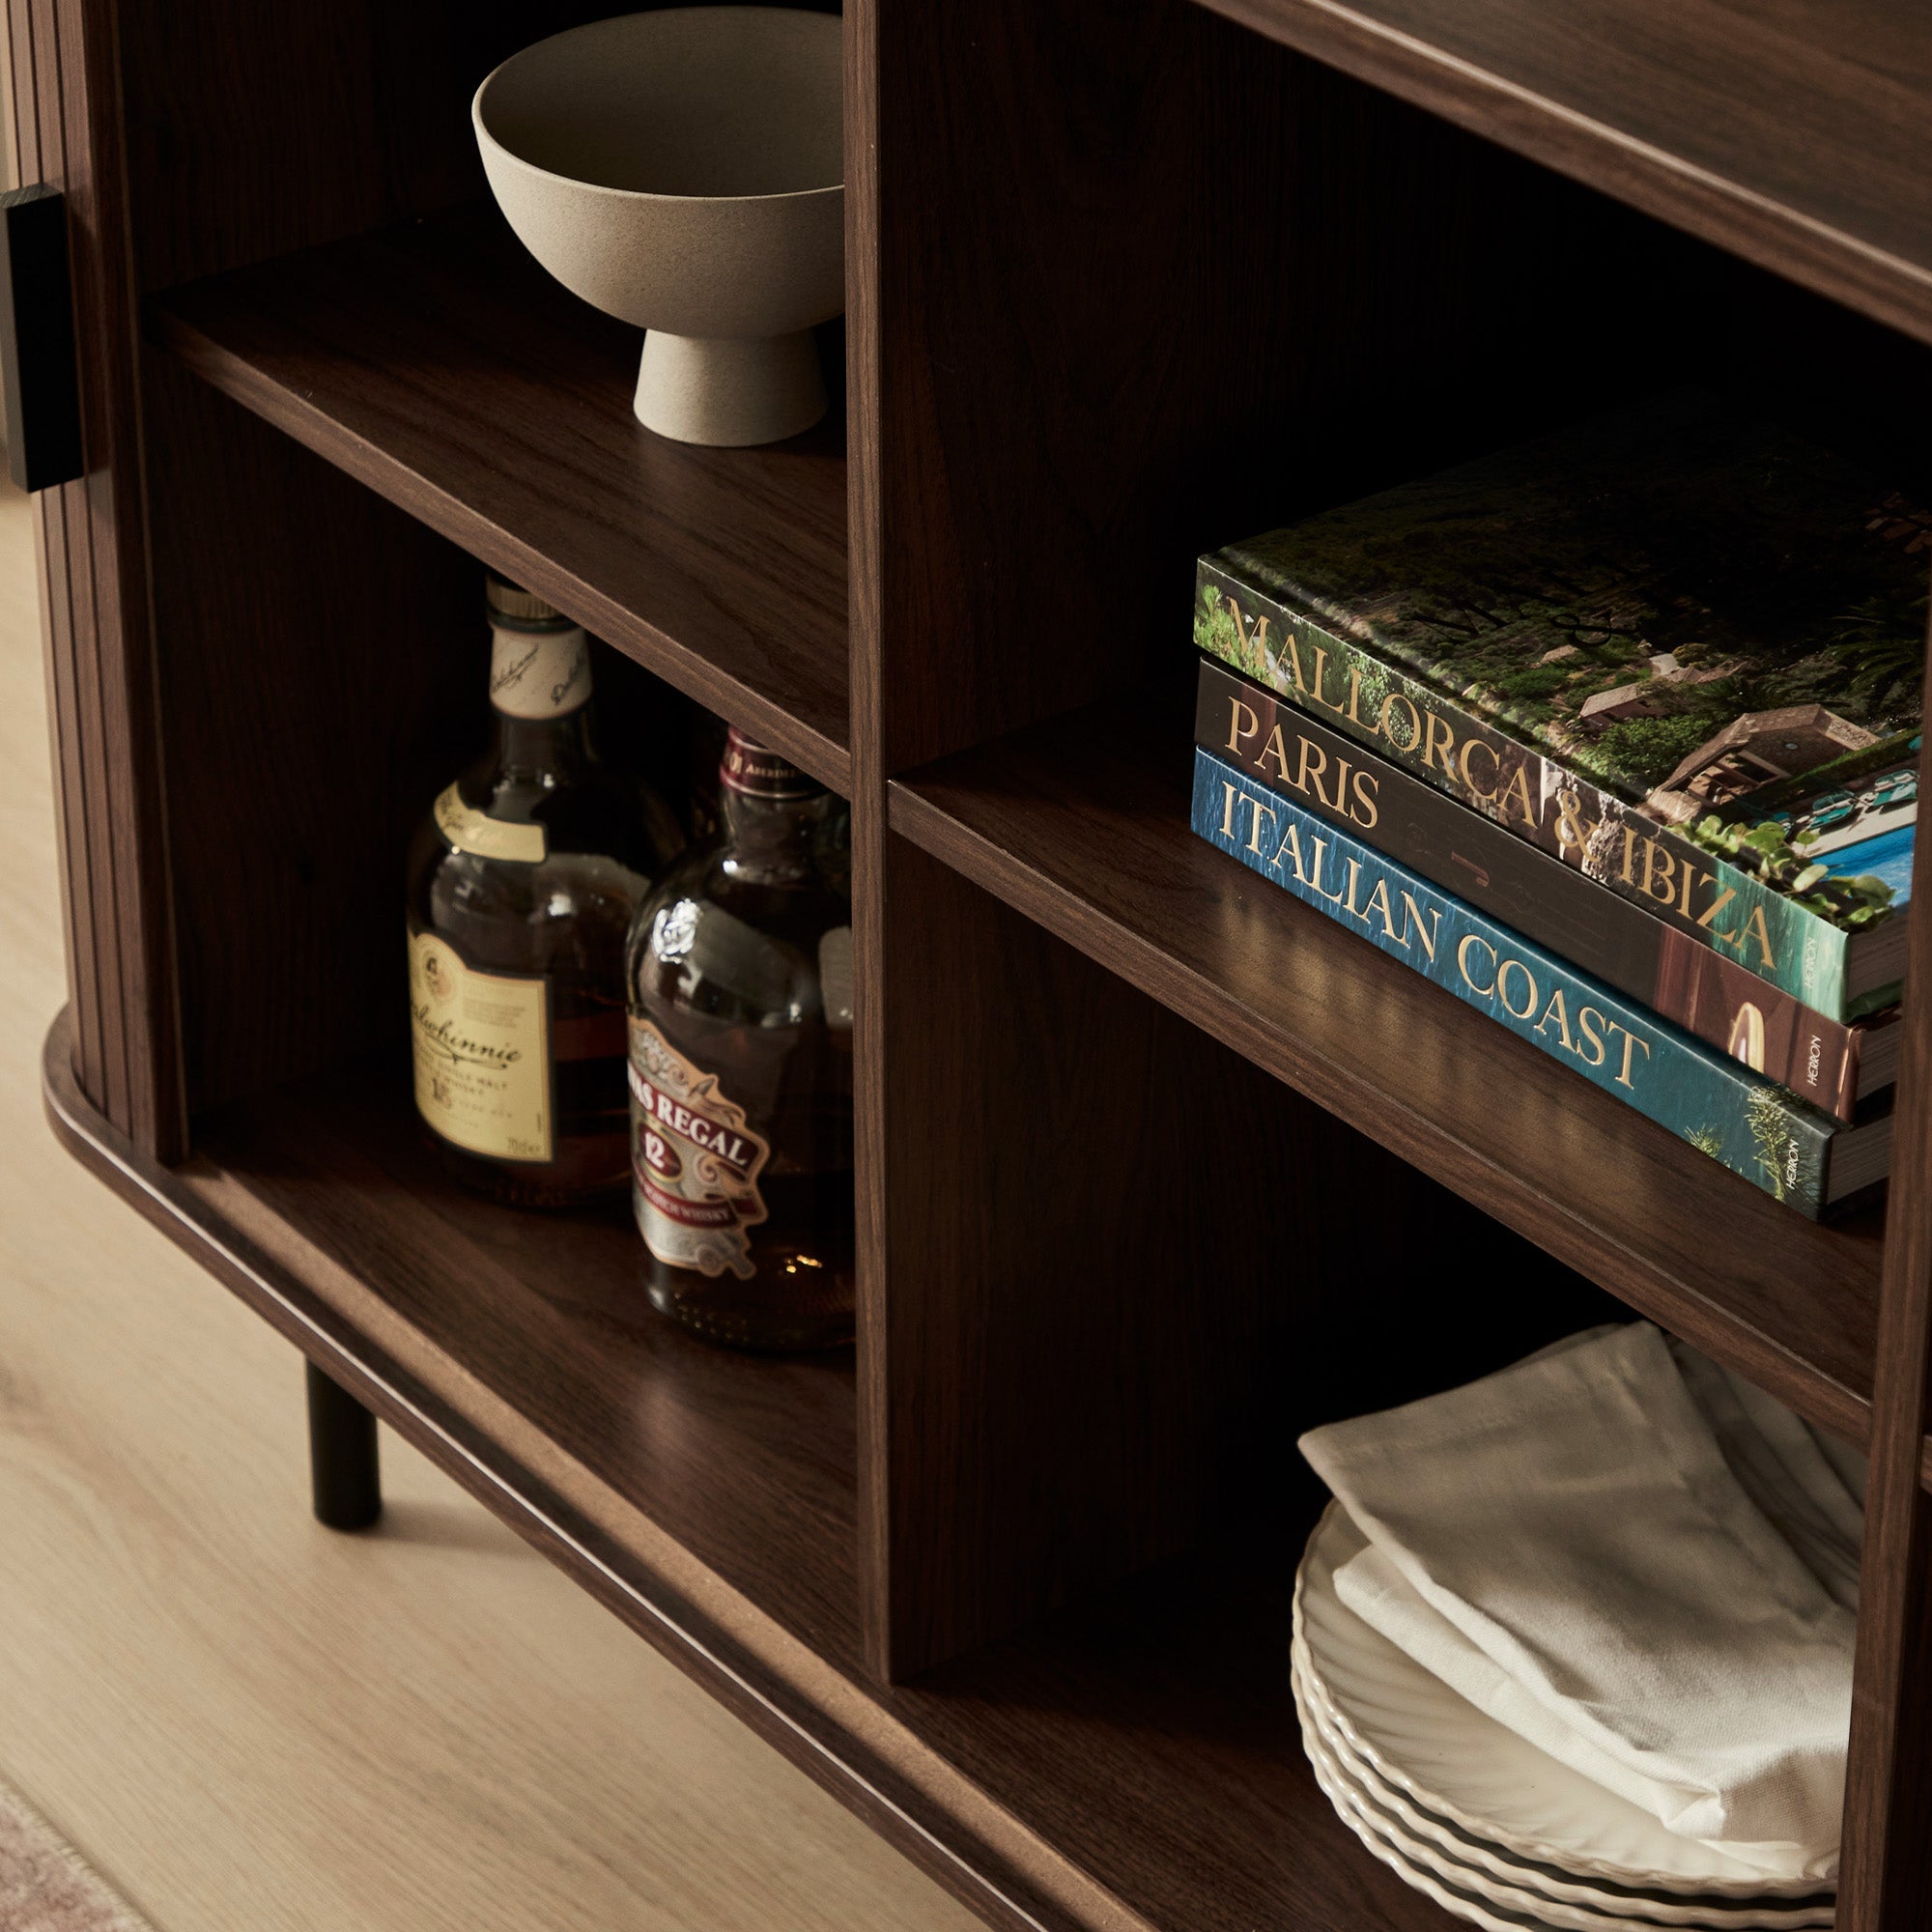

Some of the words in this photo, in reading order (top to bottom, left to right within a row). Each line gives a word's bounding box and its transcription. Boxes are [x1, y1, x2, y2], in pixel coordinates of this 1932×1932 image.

[1225, 696, 1379, 829] PARIS
[1227, 596, 1538, 830] MALLORCA
[1554, 790, 1603, 863] &
[1619, 825, 1777, 970] IBIZA
[1220, 781, 1443, 963] ITALIAN
[1458, 934, 1651, 1091] COAST
[1807, 1035, 1822, 1087] HERRON
[645, 1131, 666, 1169] 12
[657, 1094, 747, 1166] REGAL
[1786, 1139, 1800, 1190] HERRON
[680, 1207, 730, 1222] WHISKY
